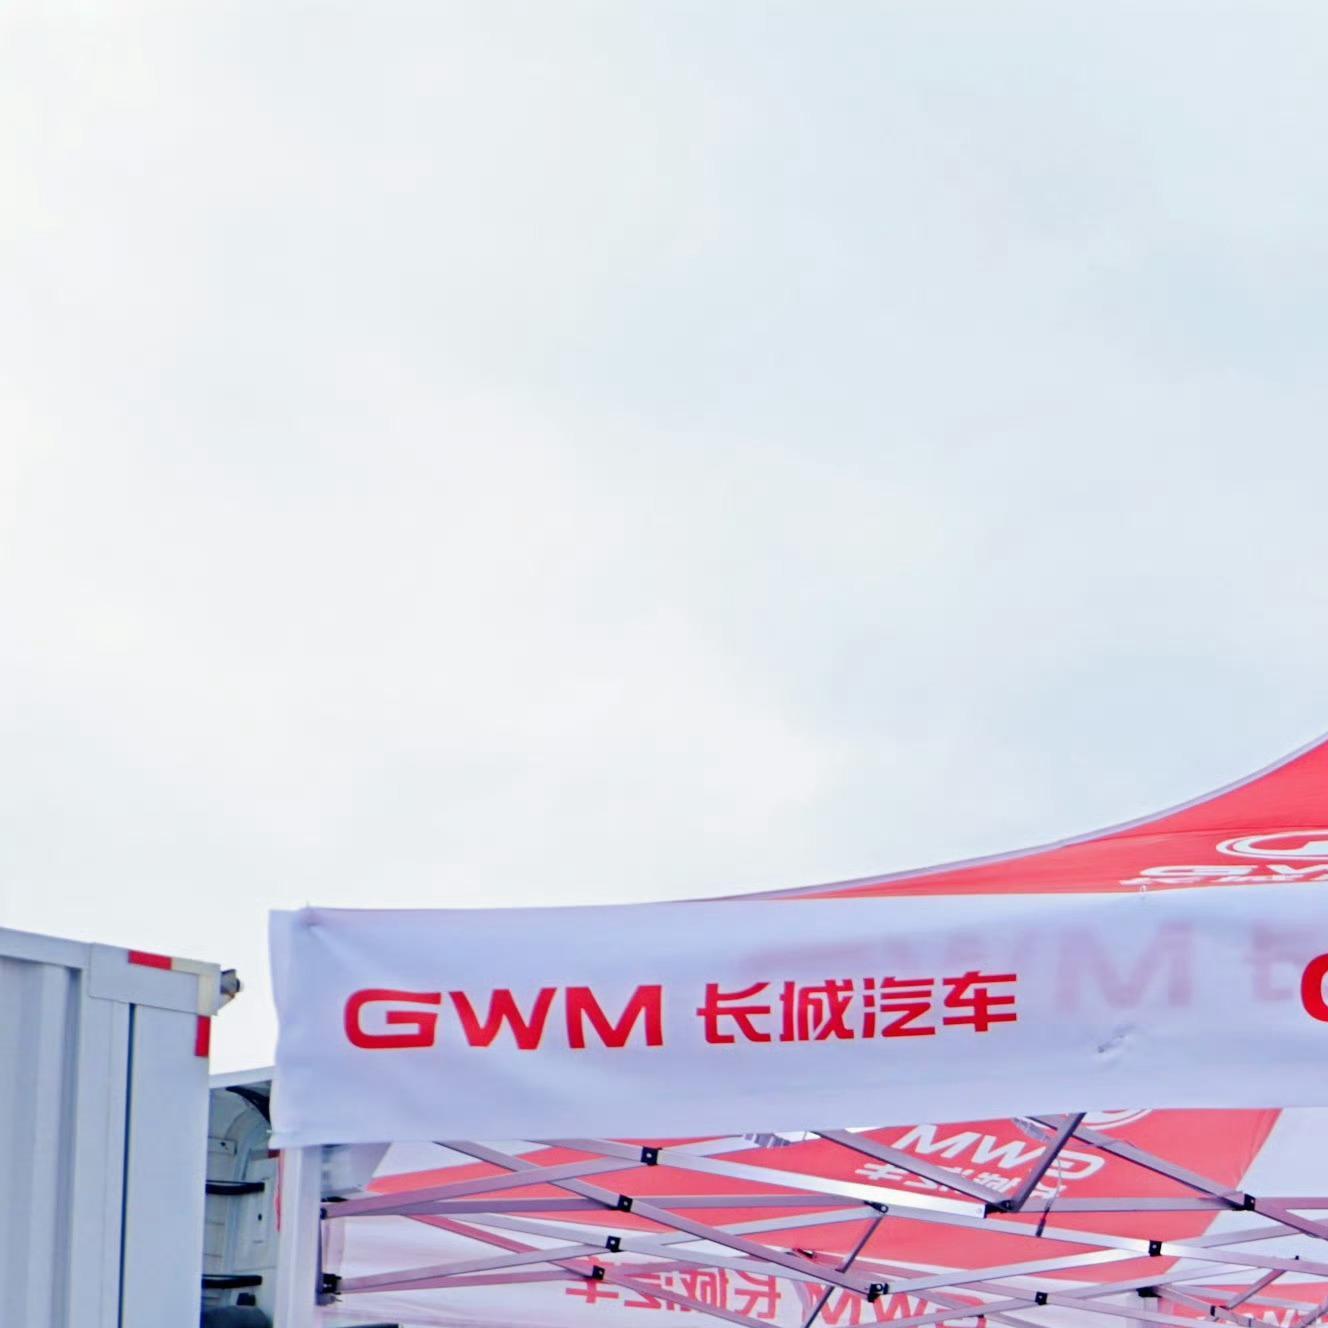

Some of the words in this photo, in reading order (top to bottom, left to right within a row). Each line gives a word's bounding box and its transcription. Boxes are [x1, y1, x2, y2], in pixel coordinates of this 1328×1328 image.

[343, 983, 665, 1051] GWM
[697, 970, 1018, 1045] 长城汽车
